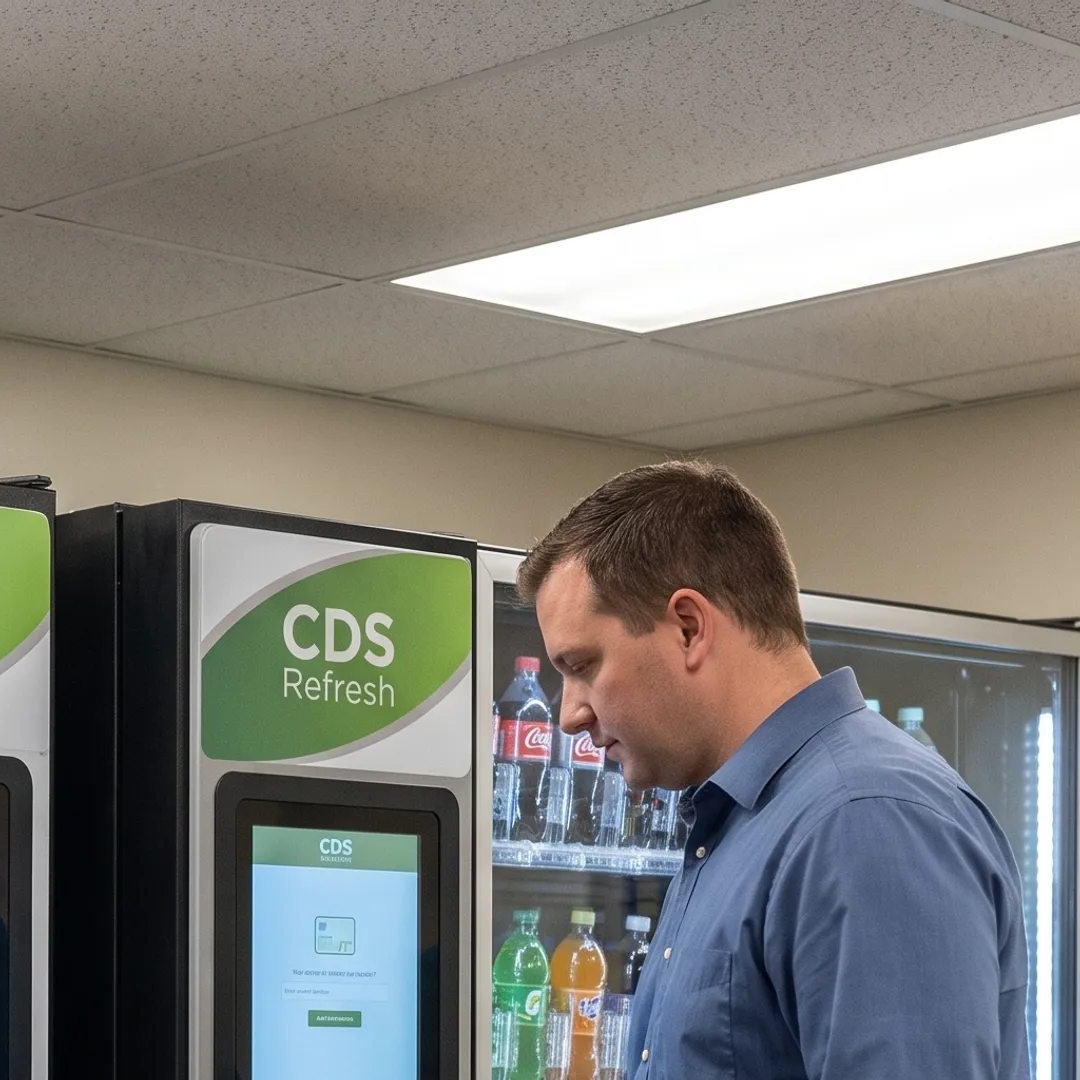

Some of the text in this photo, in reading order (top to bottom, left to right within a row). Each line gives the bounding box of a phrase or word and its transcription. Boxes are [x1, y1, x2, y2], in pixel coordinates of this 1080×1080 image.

[283, 603, 395, 667] CDS
[283, 667, 395, 707] Refresh
[319, 838, 353, 856] CDS
